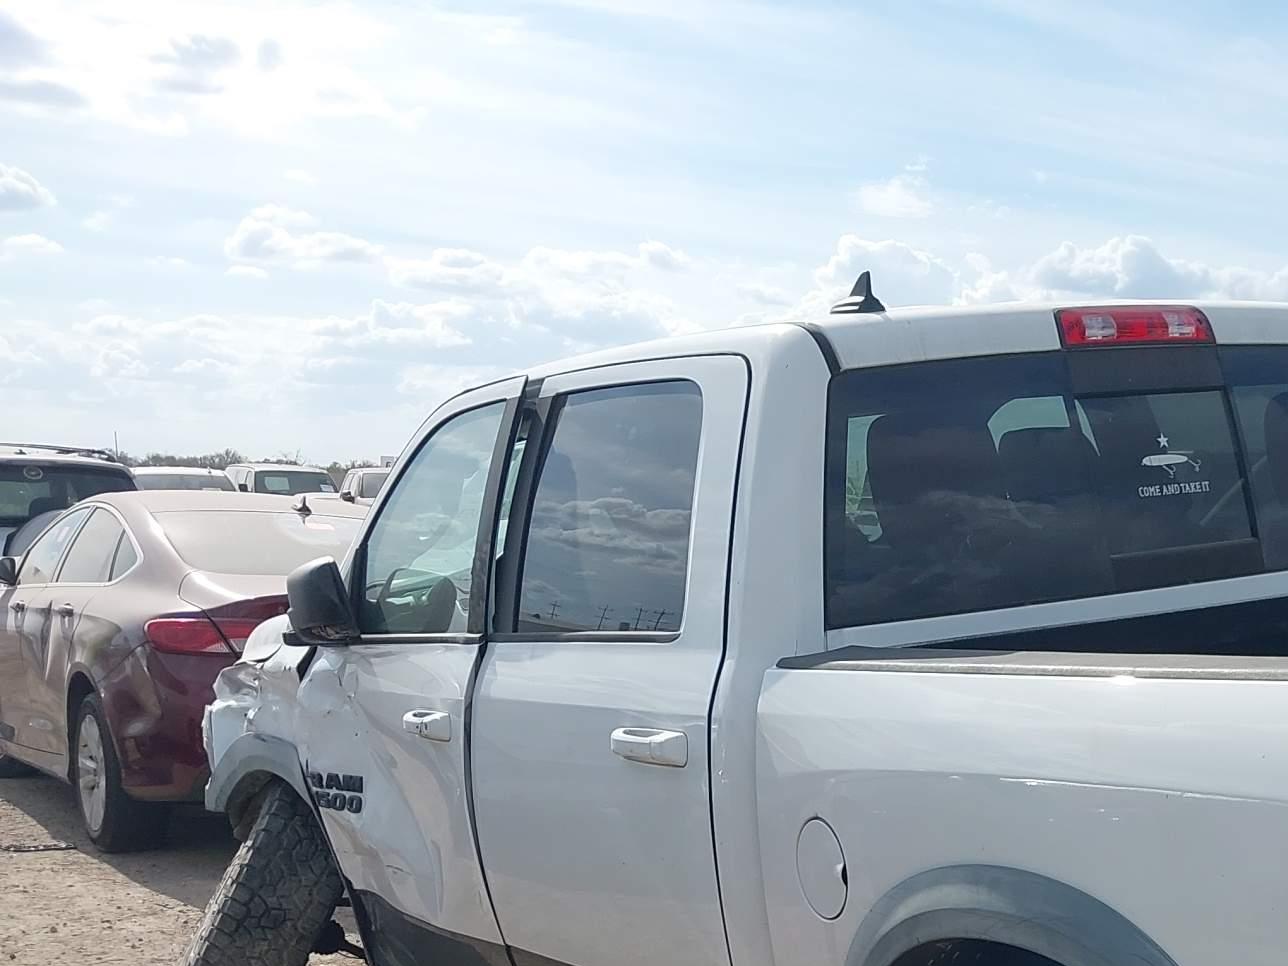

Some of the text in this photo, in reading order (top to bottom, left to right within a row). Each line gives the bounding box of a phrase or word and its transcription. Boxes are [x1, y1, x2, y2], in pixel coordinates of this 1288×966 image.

[1138, 480, 1210, 498] COME AND TAKE IT
[309, 770, 364, 794] RAM
